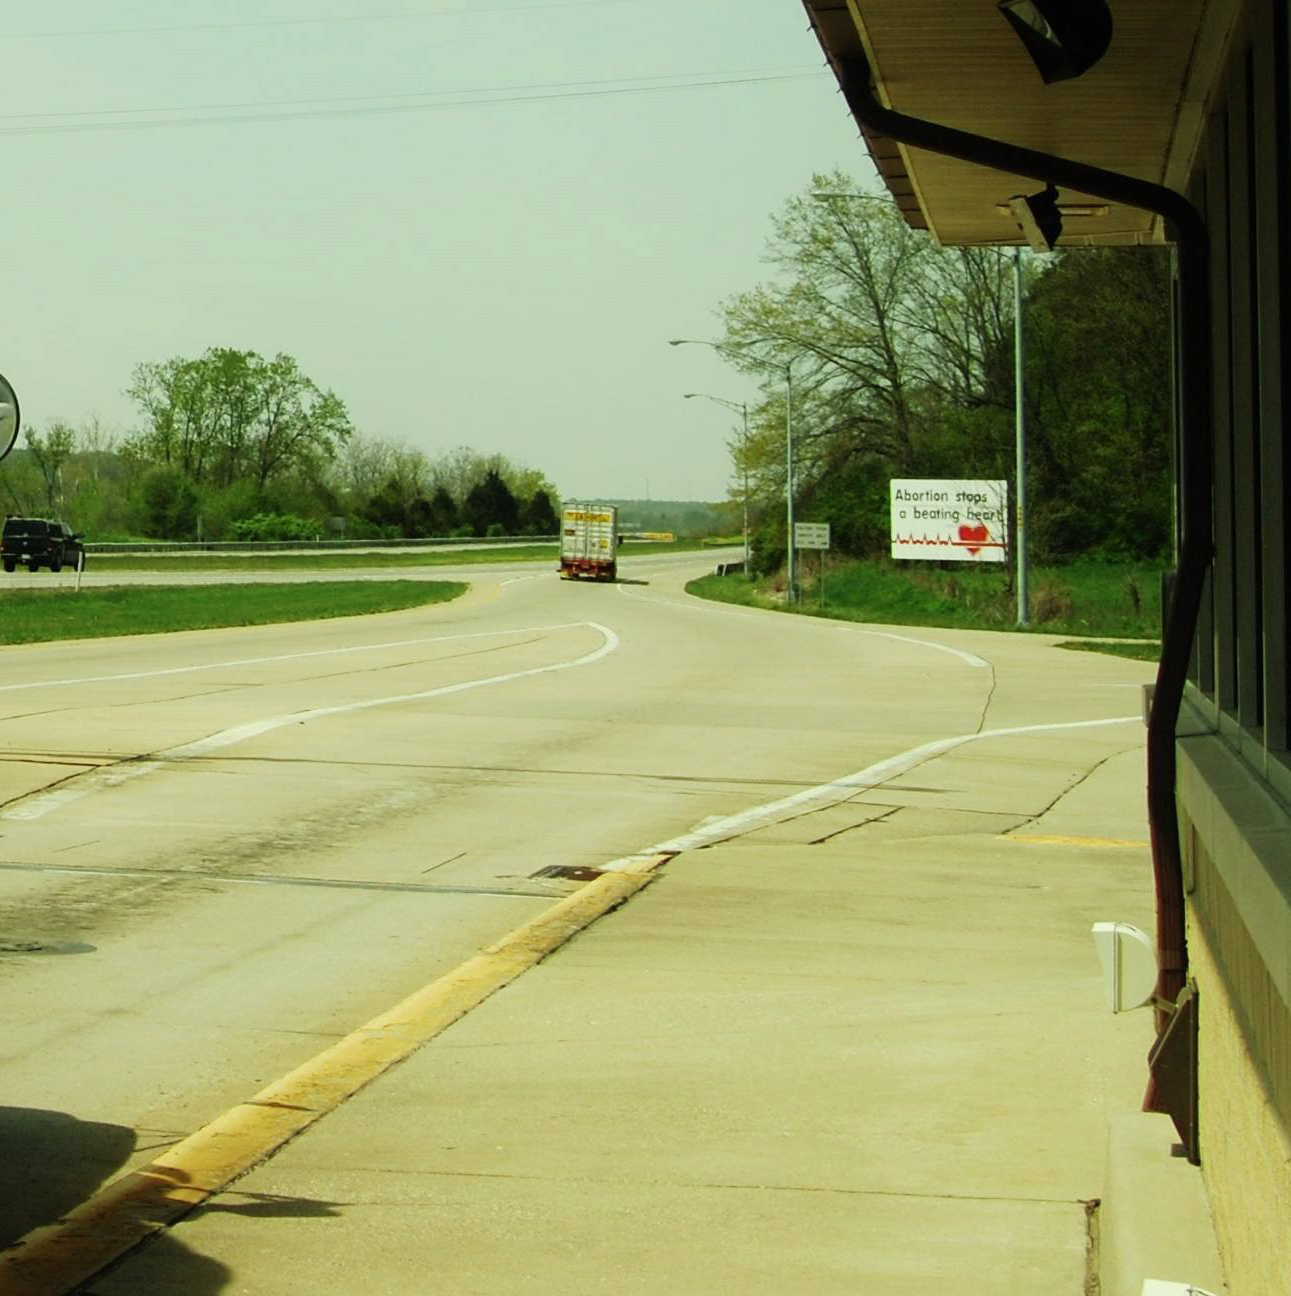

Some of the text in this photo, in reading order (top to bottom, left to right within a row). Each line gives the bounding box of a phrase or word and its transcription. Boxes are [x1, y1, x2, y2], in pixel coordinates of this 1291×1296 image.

[895, 489, 988, 504] Abortion stops
[899, 510, 907, 519] a
[913, 507, 960, 523] beating
